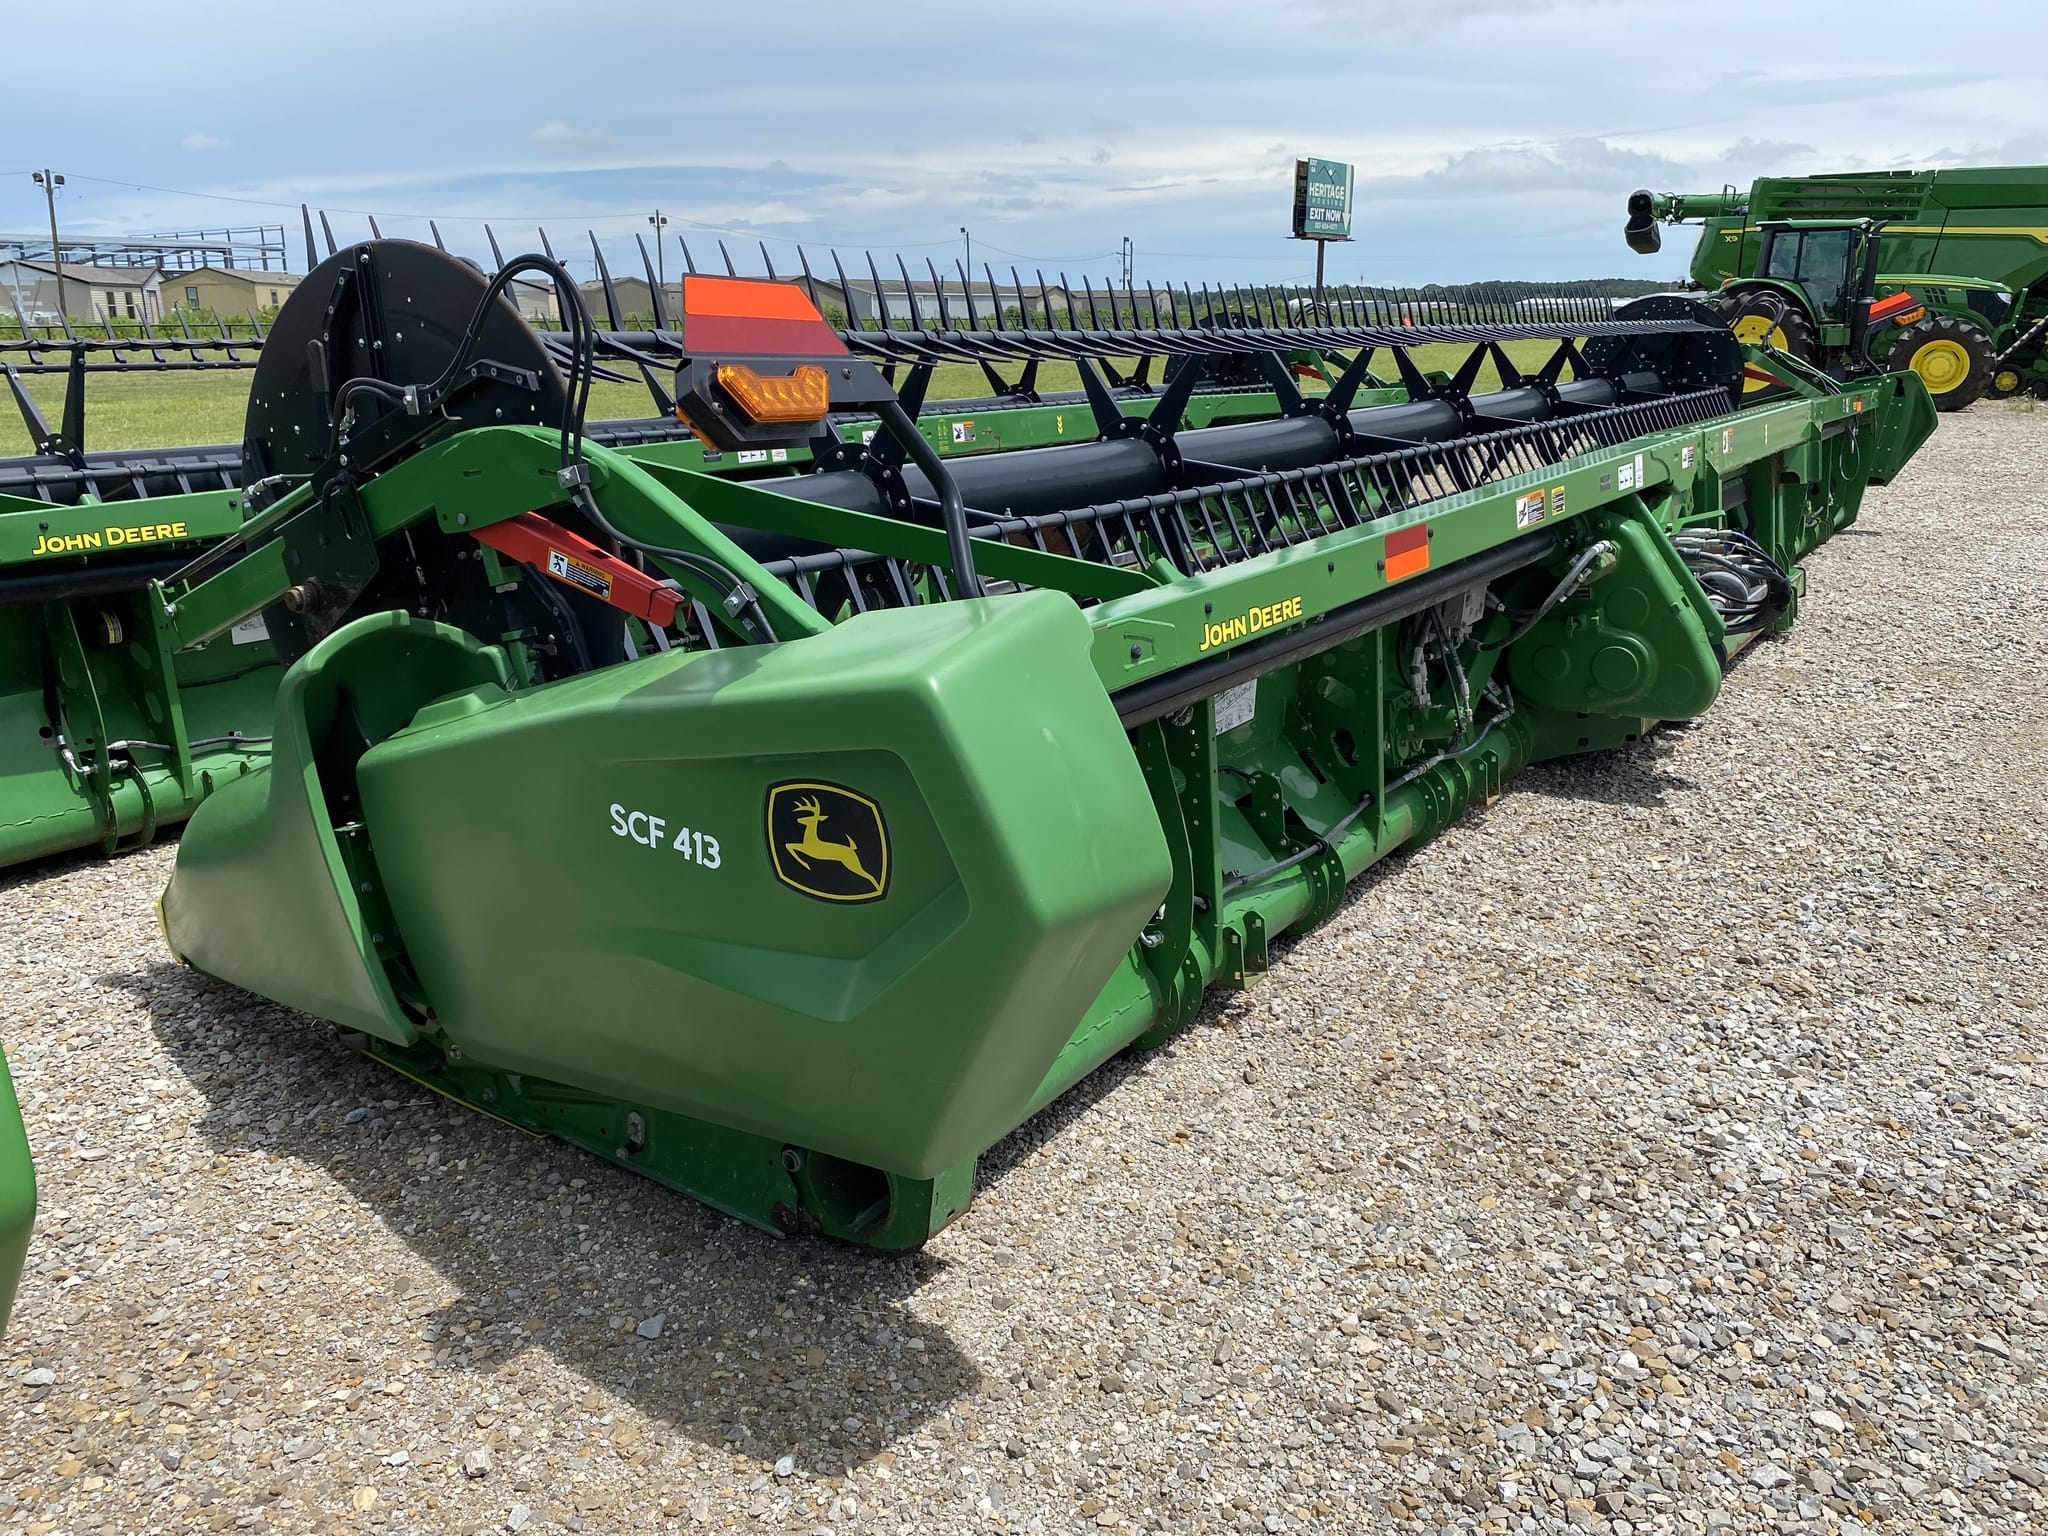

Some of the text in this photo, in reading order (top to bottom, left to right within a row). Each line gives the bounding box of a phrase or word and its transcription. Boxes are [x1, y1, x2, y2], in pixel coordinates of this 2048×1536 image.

[1309, 182, 1345, 200] HERITAGE
[1312, 198, 1342, 207] HOUSING
[1309, 208, 1341, 222] EXIT NOW
[1724, 235, 1738, 243] X9
[32, 522, 188, 556] JOHN DEERE
[1199, 595, 1303, 651] JOHN DEERE
[609, 803, 721, 869] SCF 413
